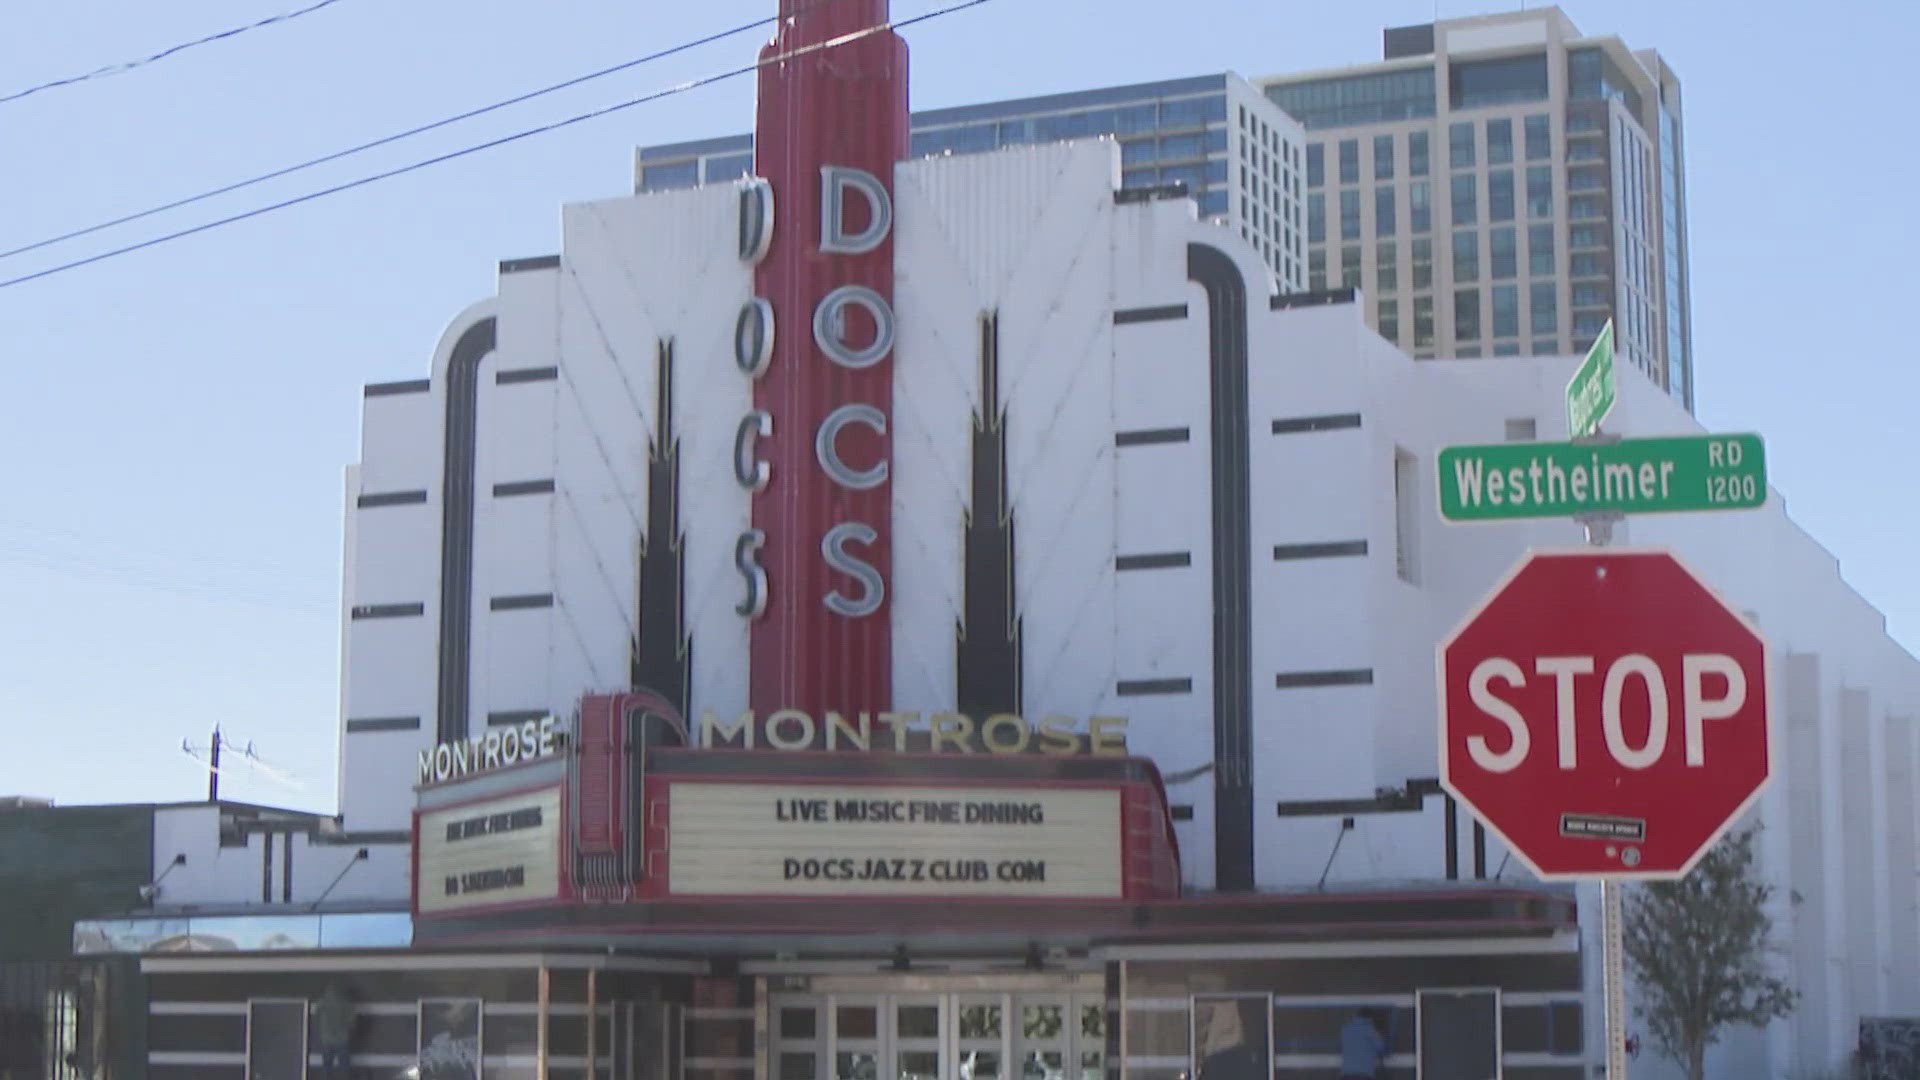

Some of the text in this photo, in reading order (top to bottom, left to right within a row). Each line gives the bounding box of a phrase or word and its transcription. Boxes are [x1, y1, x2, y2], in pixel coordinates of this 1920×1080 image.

[735, 180, 775, 621] DOCS
[813, 166, 895, 617] DOCS
[1455, 441, 1743, 508] Westheimer RD
[1706, 475, 1756, 502] 1200
[700, 709, 1129, 756] MONTROSE
[1466, 653, 1747, 773] STOP
[418, 715, 555, 785] MONTROSE
[776, 799, 1044, 824] LIVE MUSIC FINE DINING
